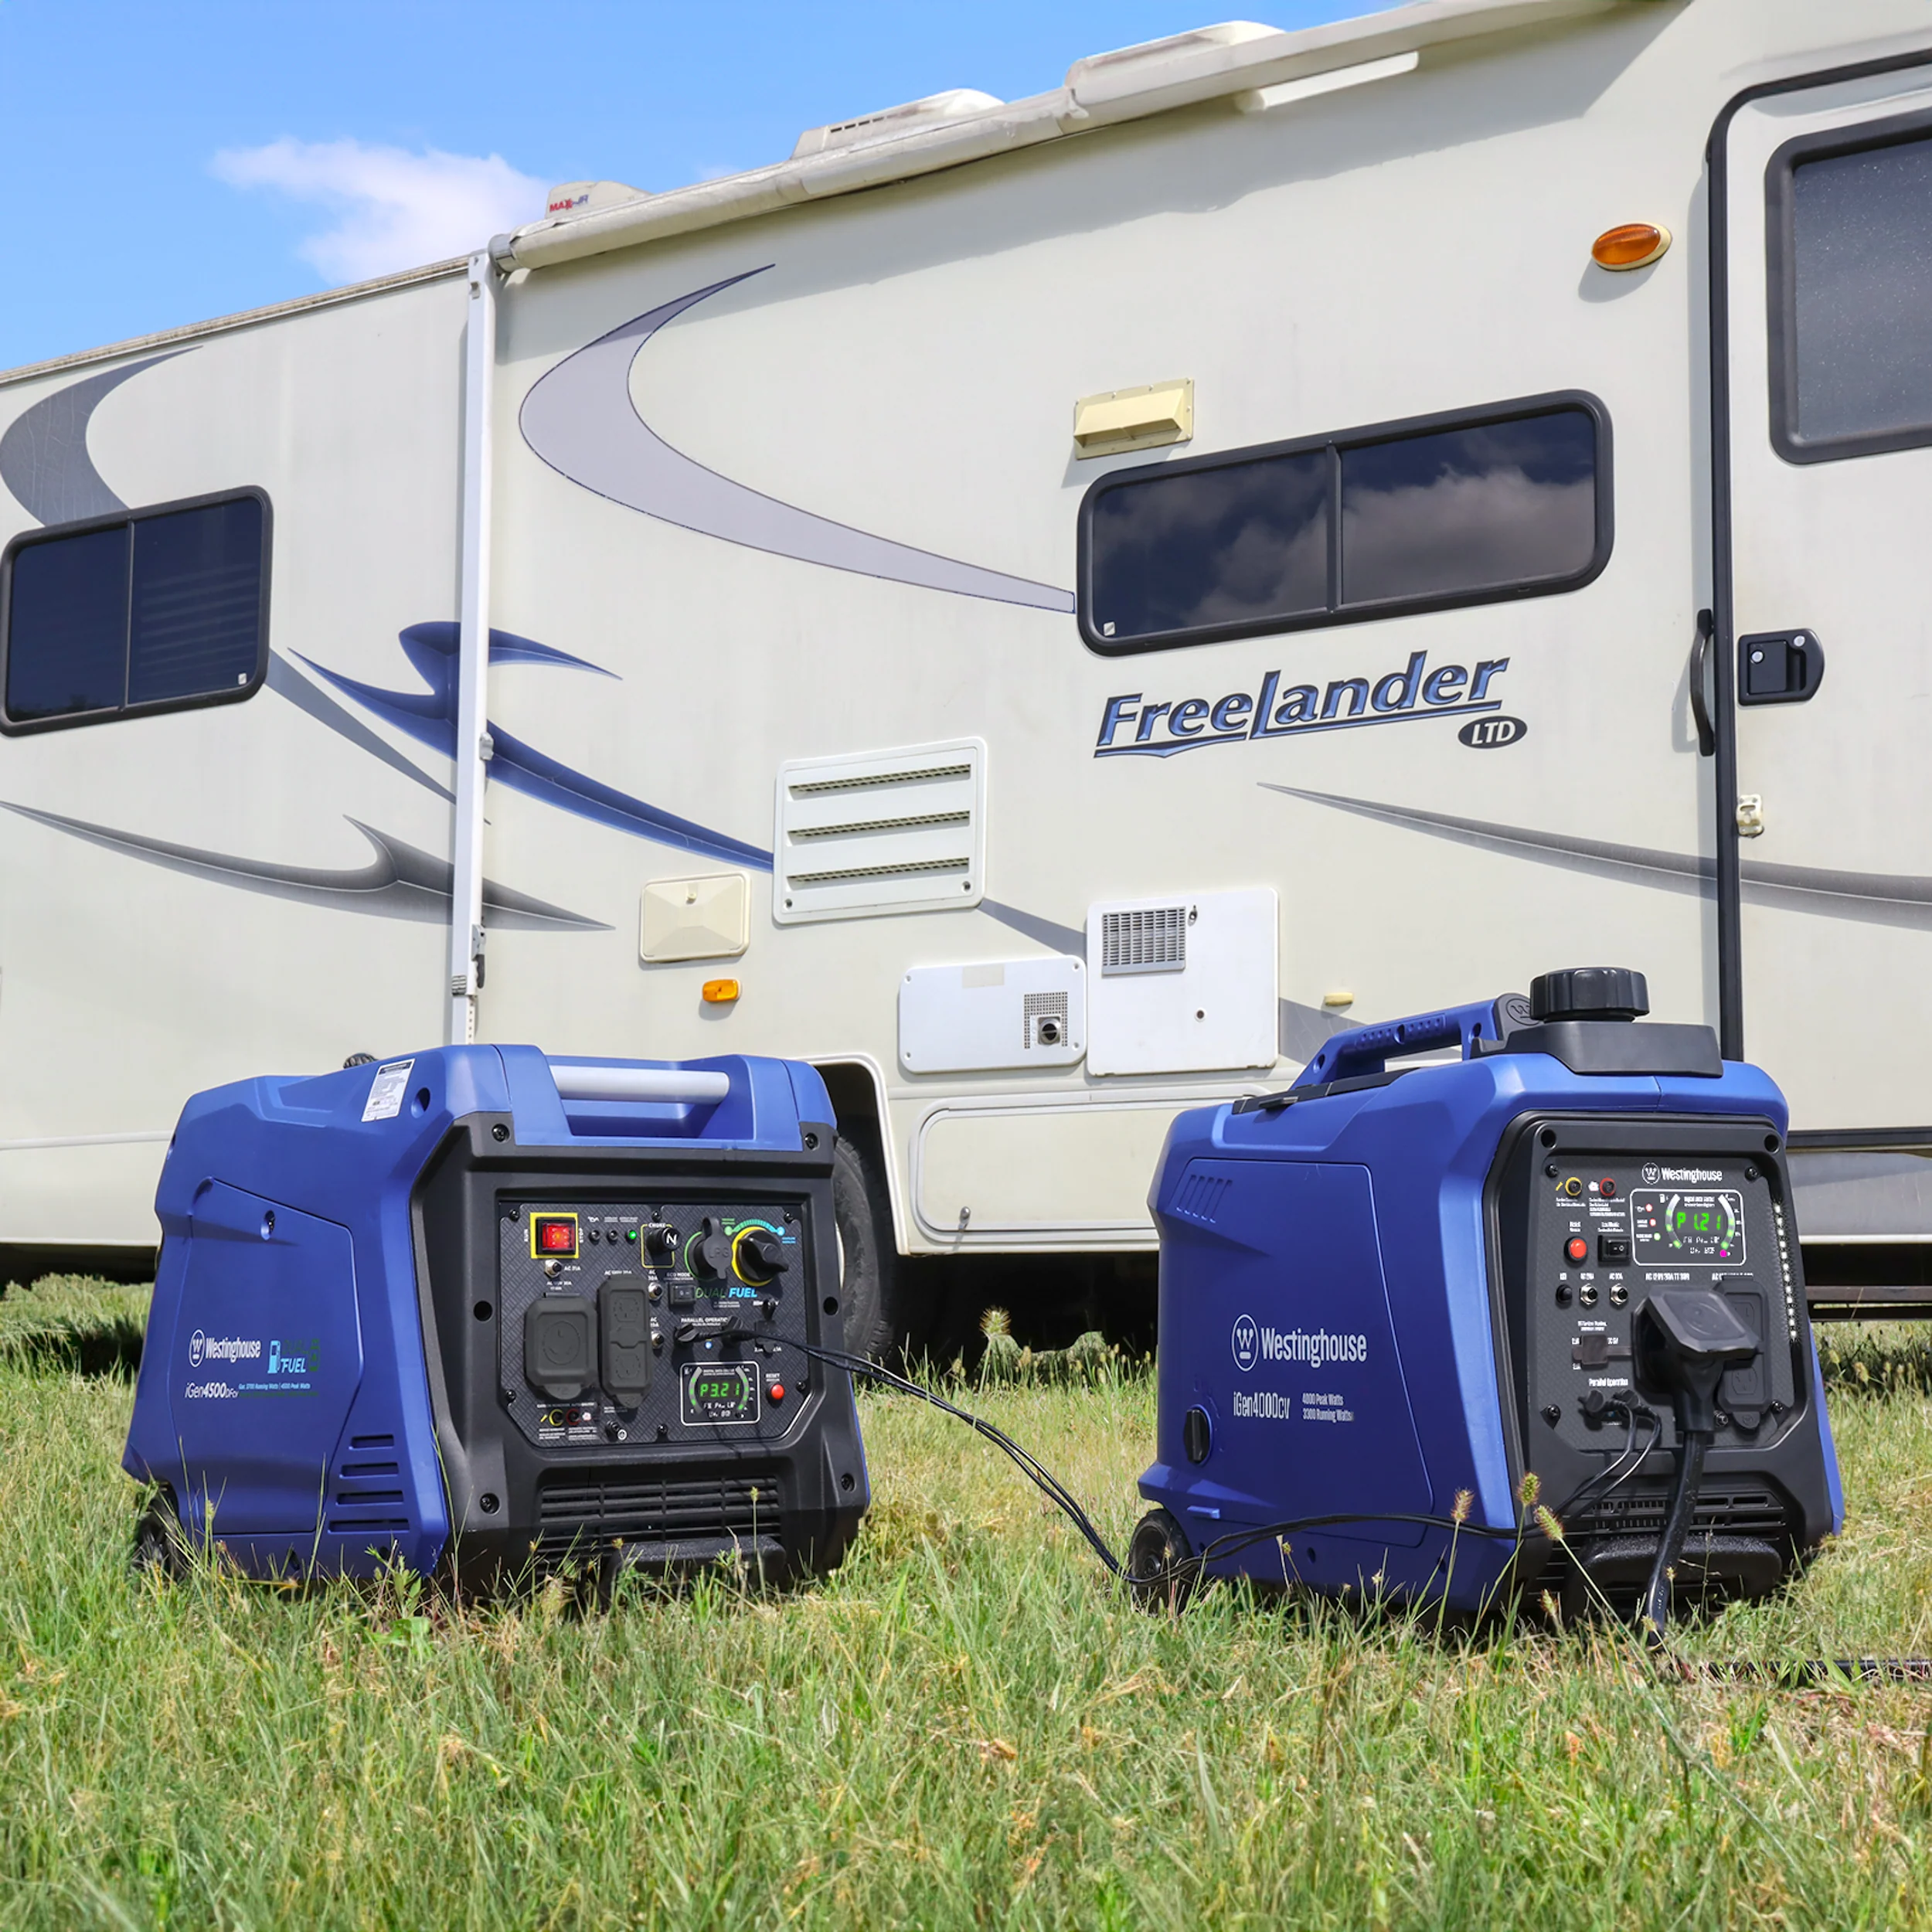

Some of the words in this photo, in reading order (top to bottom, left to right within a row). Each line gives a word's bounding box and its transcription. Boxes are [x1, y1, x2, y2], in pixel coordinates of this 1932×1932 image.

[1096, 650, 1510, 747] Freelander
[1471, 719, 1515, 745] LTD
[1662, 1168, 1723, 1183] Westinghouse
[728, 1287, 758, 1298] FUEL
[206, 1336, 261, 1363] Westinghouse
[1261, 1327, 1367, 1369] Westinghouse
[281, 1358, 306, 1373] FUEL
[1316, 1393, 1328, 1405] Peak
[1328, 1394, 1344, 1406] Watts
[1316, 1409, 1336, 1423] Running
